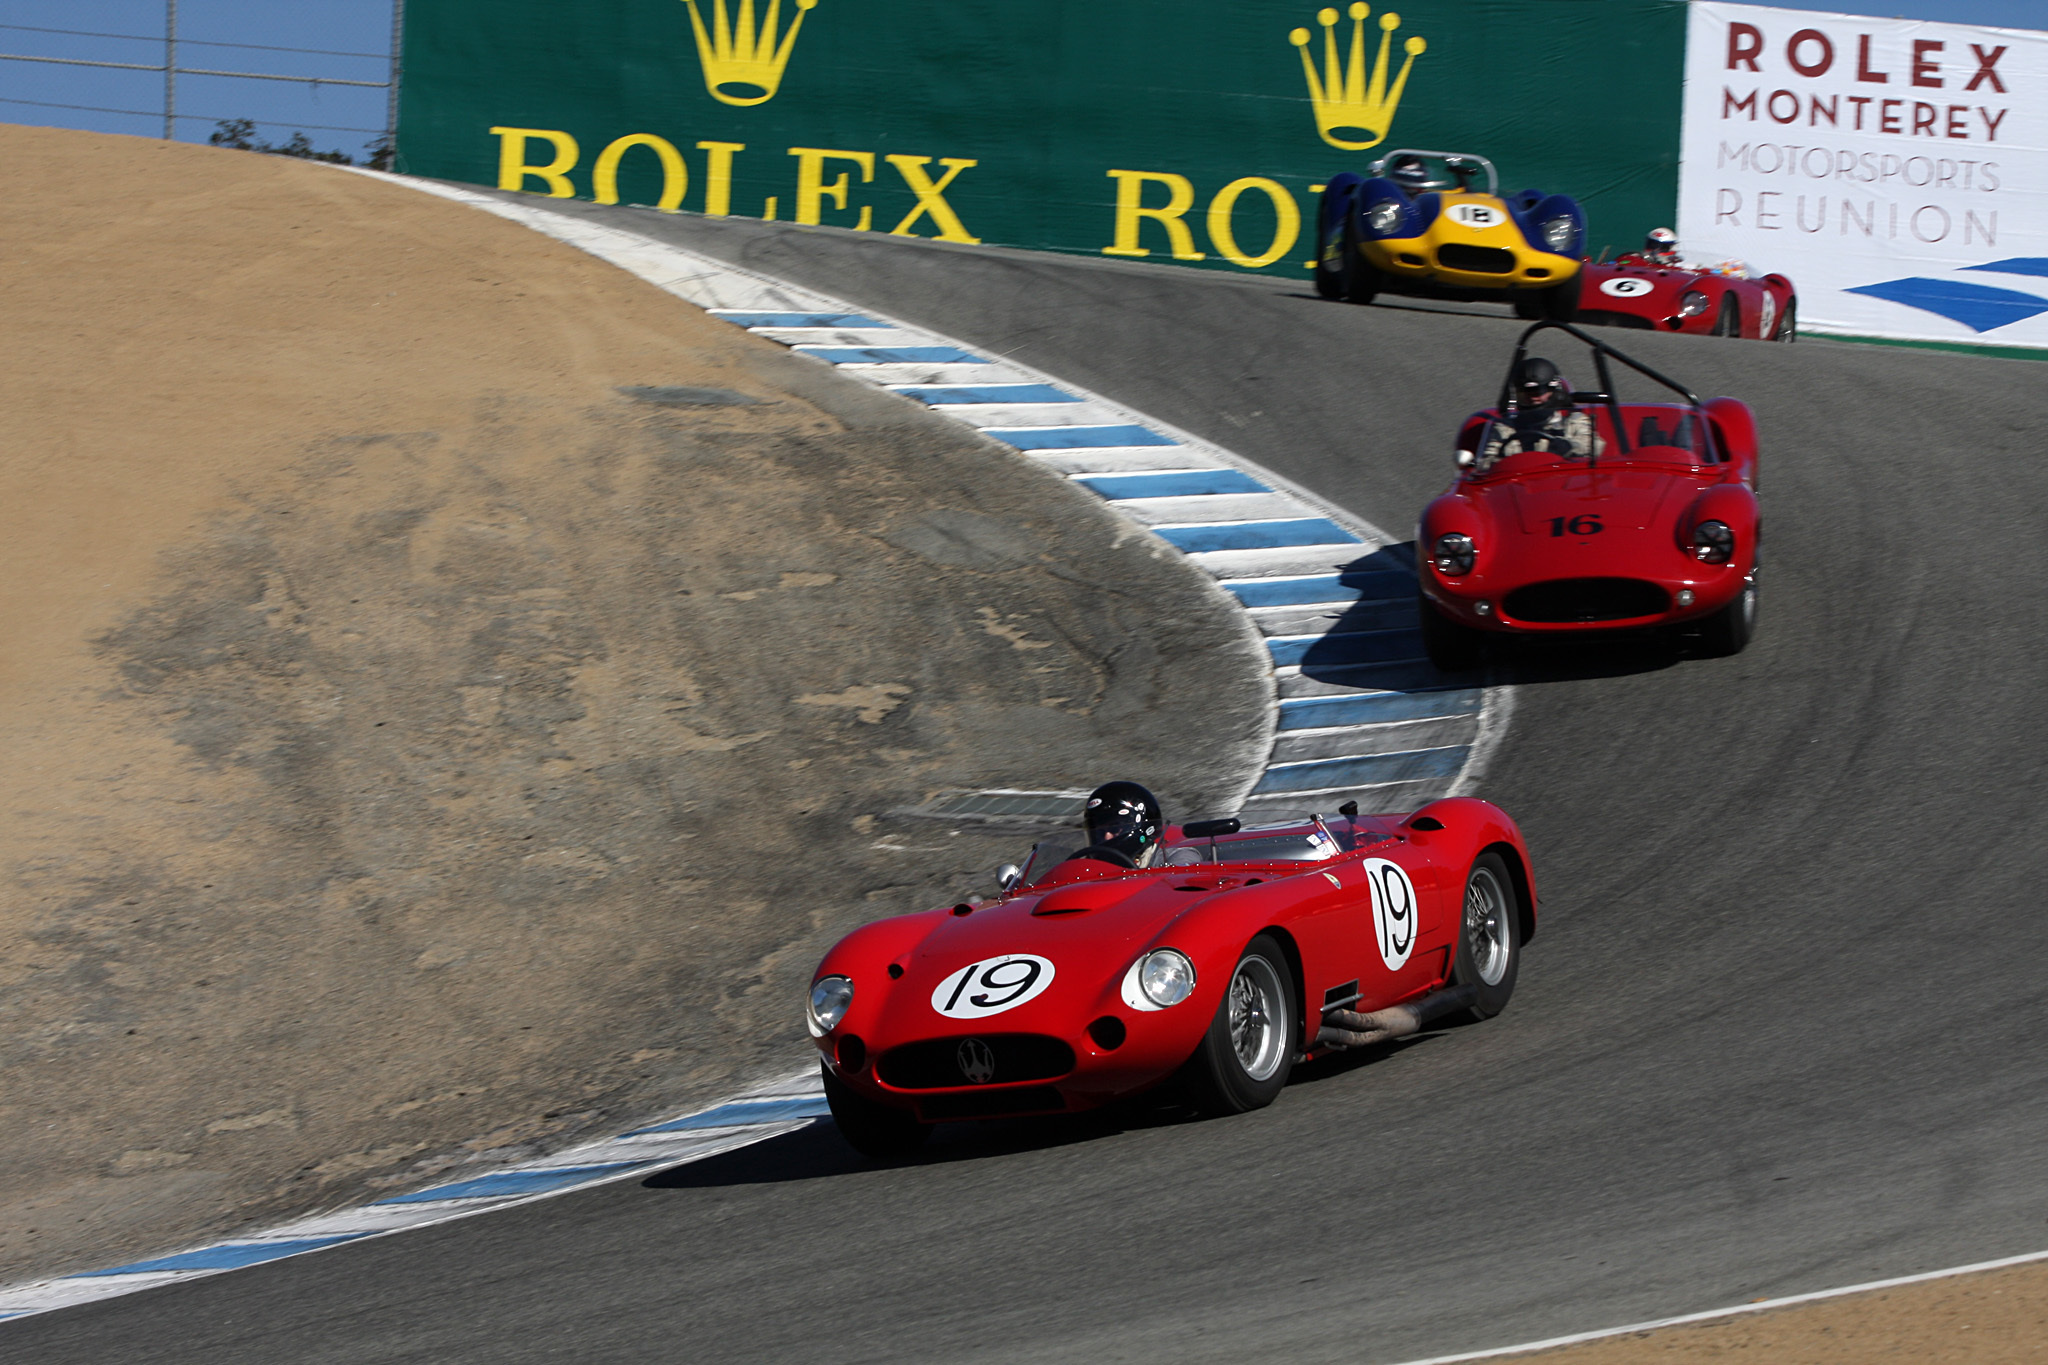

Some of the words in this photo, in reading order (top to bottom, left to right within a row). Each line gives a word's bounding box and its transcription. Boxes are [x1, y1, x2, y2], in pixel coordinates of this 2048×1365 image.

[1725, 21, 2009, 93] ROLEX
[1721, 85, 2009, 141] MONTEREY
[489, 126, 981, 244] ROLEX
[1716, 140, 2000, 192] MOTORSPORTS
[1102, 169, 1327, 268] RO
[1460, 206, 1491, 223] 18
[1714, 188, 1998, 247] REUNION
[1616, 281, 1639, 292] 6
[1546, 514, 1604, 538] 16
[1369, 864, 1412, 958] 19
[943, 959, 1042, 1011] 19
